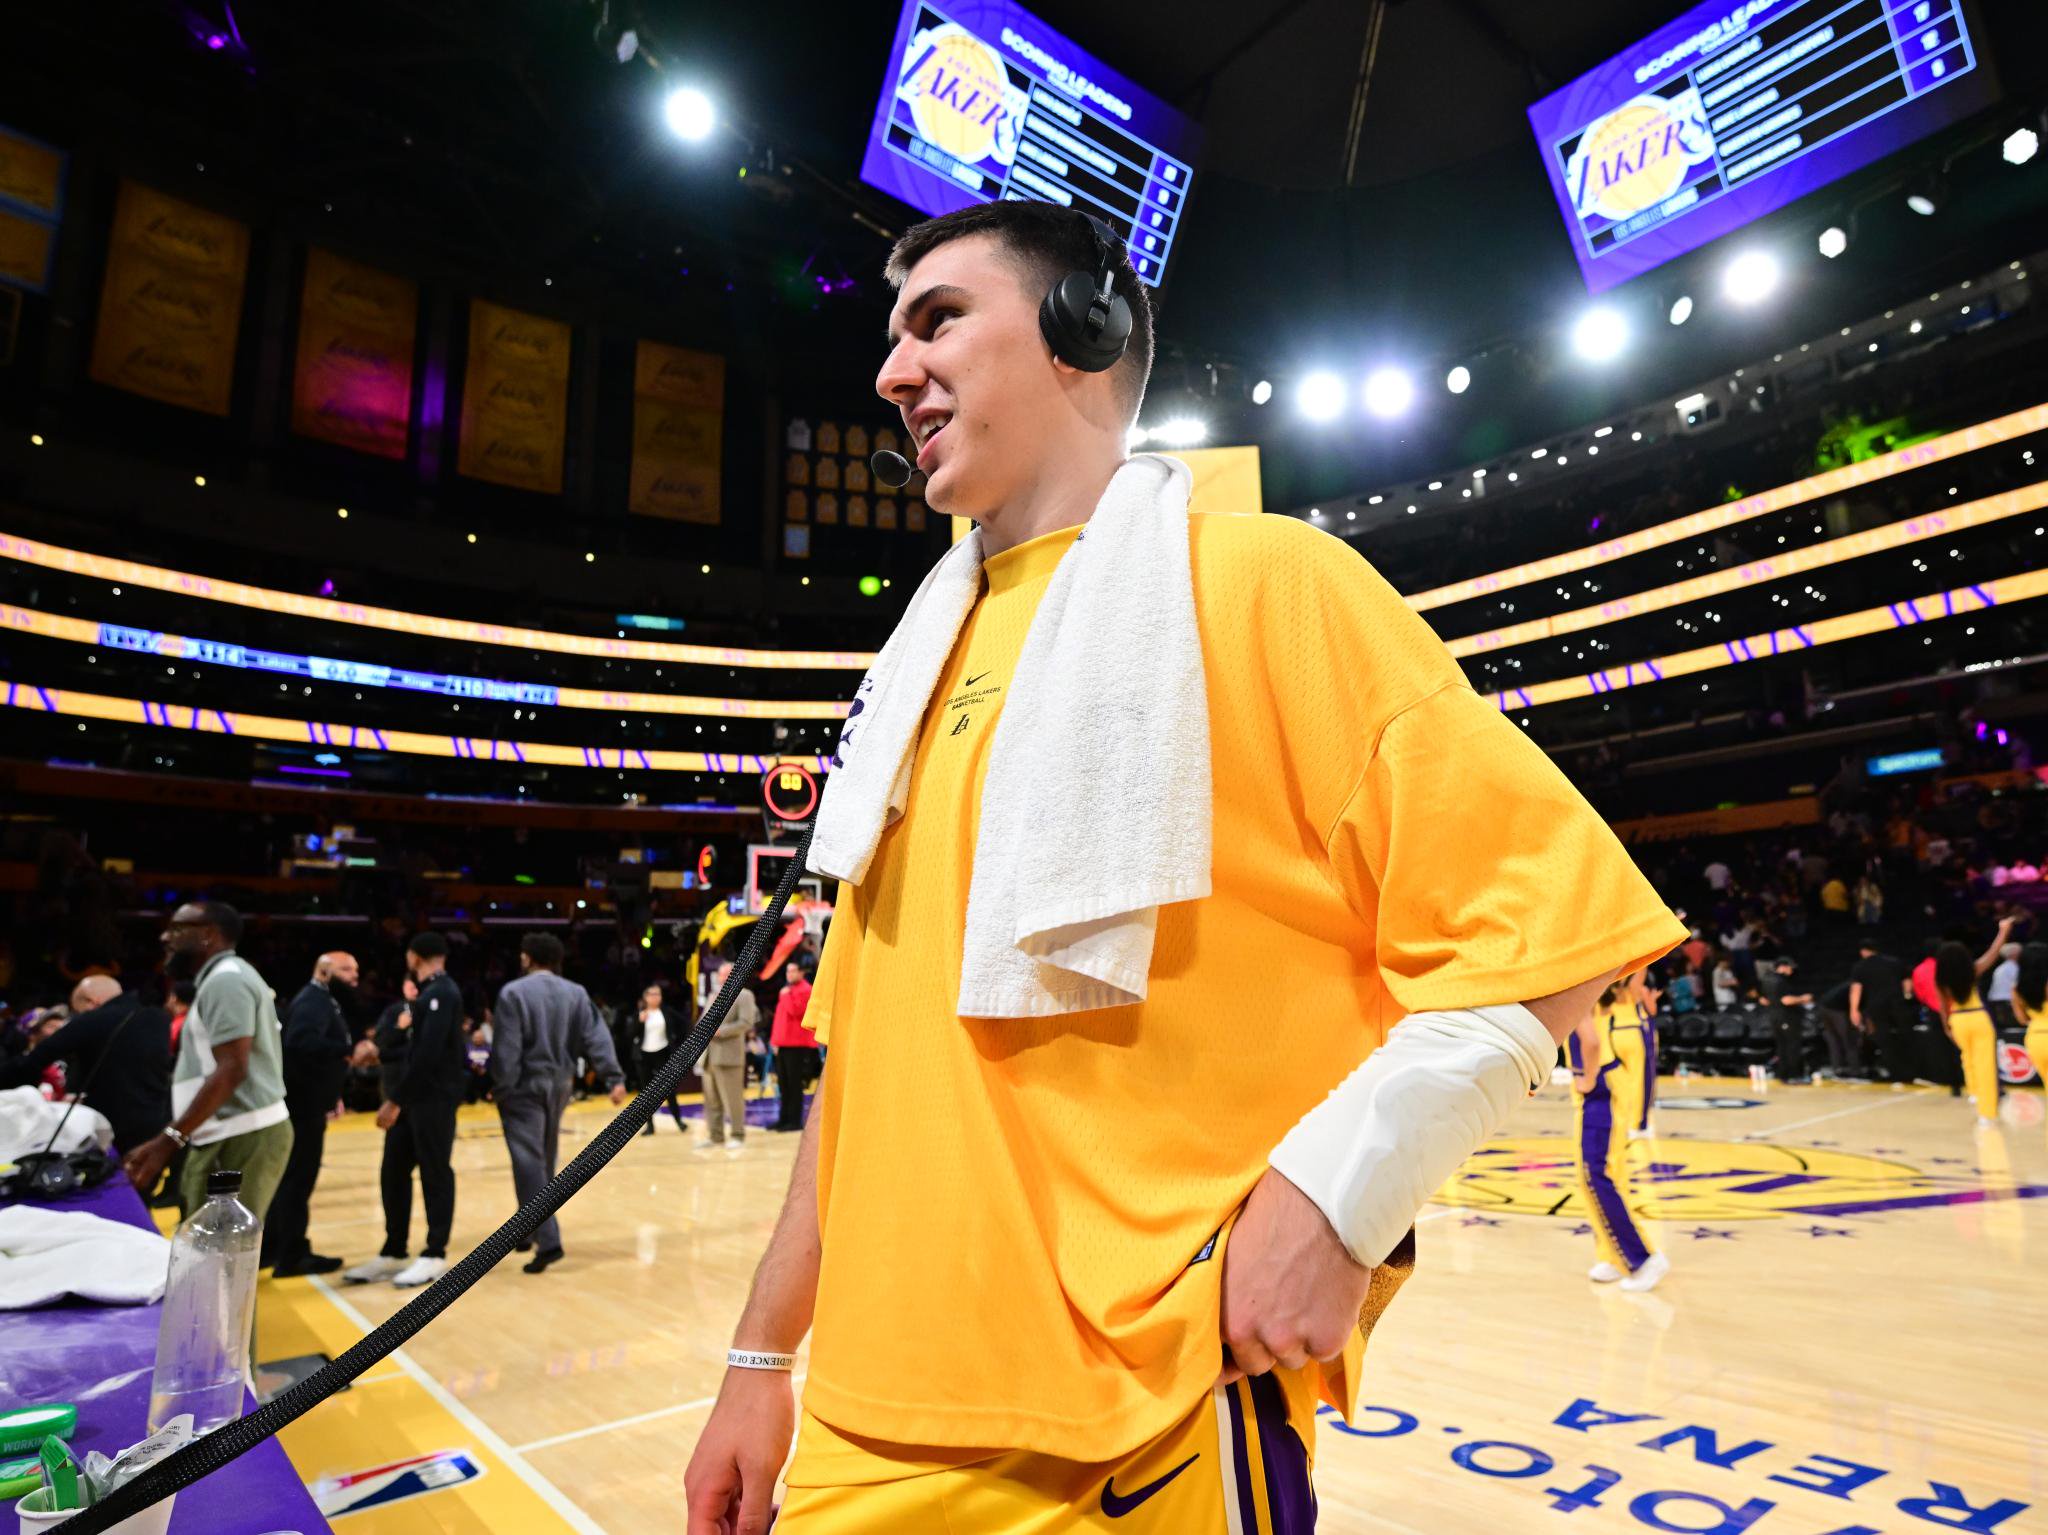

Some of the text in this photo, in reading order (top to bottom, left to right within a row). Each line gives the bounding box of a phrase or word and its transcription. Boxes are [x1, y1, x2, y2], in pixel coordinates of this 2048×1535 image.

[1721, 0, 1782, 33] LEAD
[899, 43, 1021, 155] LAKERS
[1567, 110, 1707, 211] LAKERS
[951, 696, 985, 711] BASKETBALL
[954, 691, 978, 704] ANGELES
[978, 686, 1002, 697] LAKERS
[736, 1354, 748, 1364] OF
[3, 1436, 46, 1453] WORKIN
[1310, 1403, 1884, 1535] pto.c
